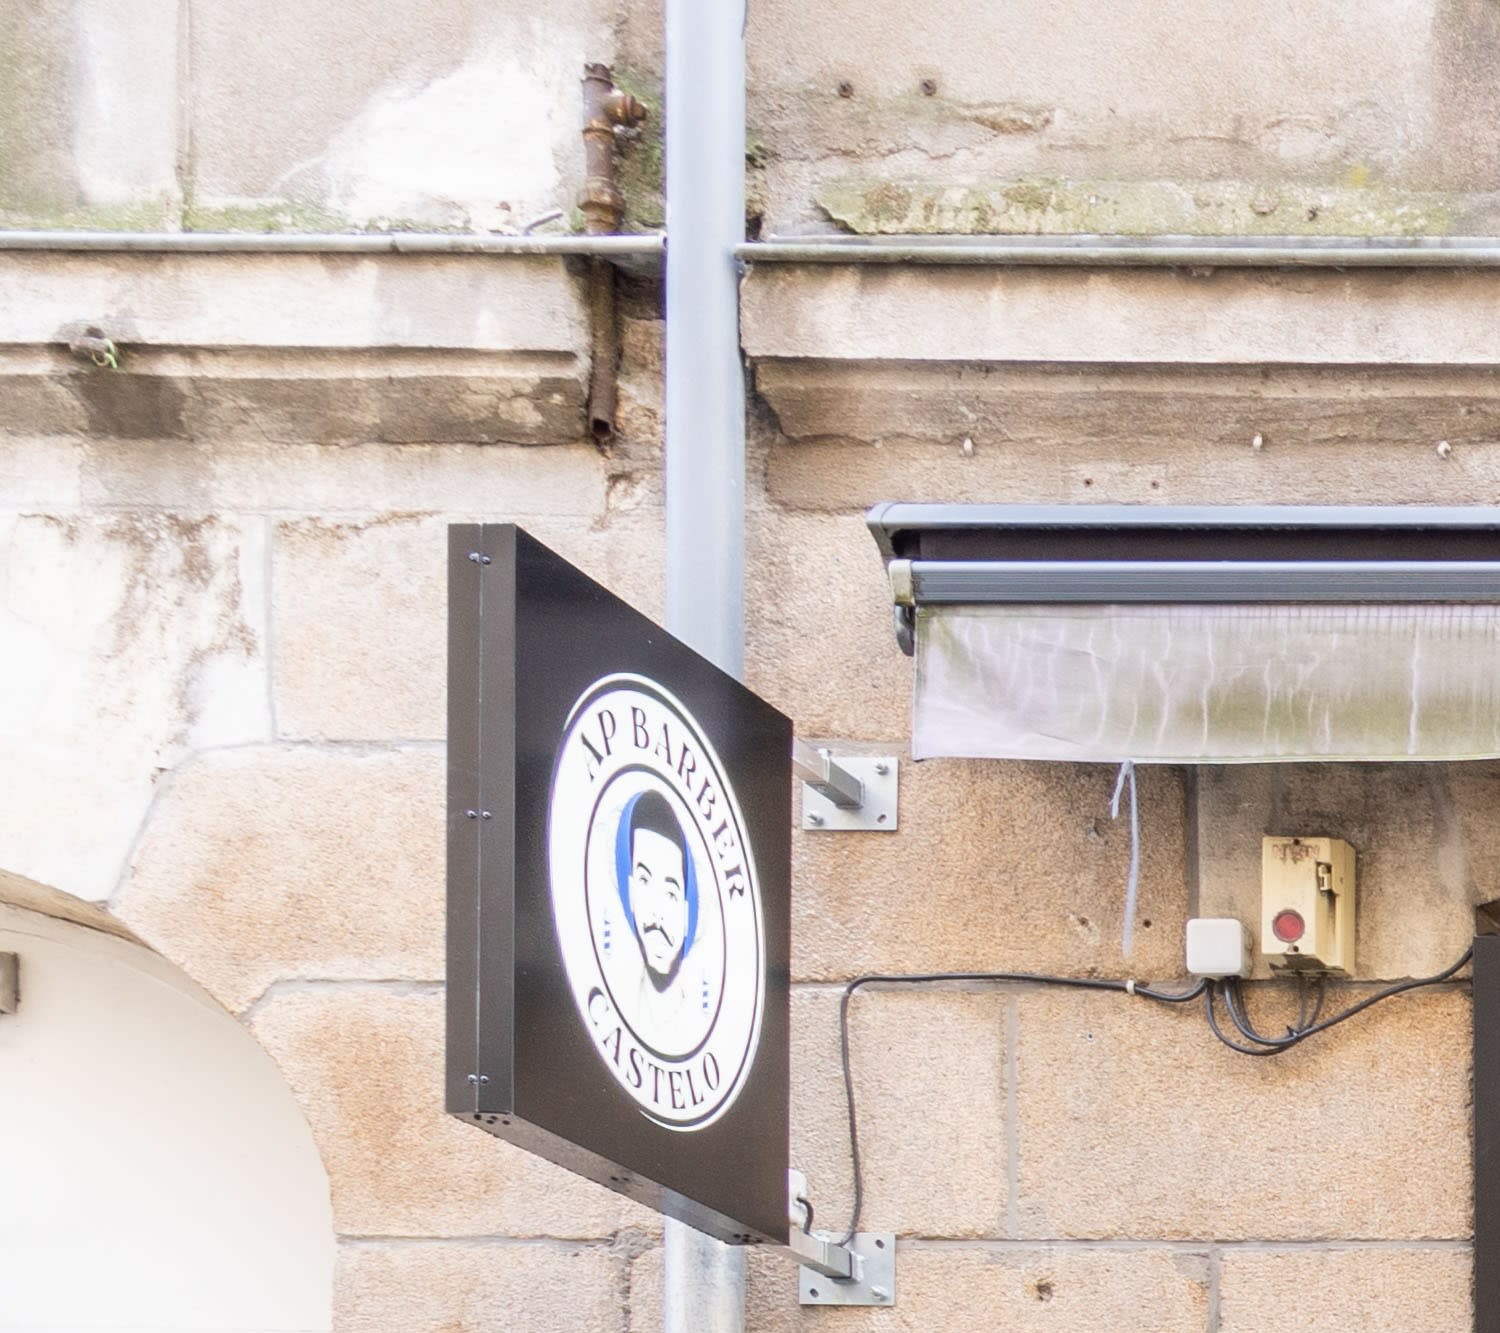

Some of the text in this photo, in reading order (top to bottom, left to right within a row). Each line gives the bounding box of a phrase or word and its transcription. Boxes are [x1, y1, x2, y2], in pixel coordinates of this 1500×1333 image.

[580, 707, 746, 900] AP BARBER
[587, 986, 721, 1110] CASTELO
